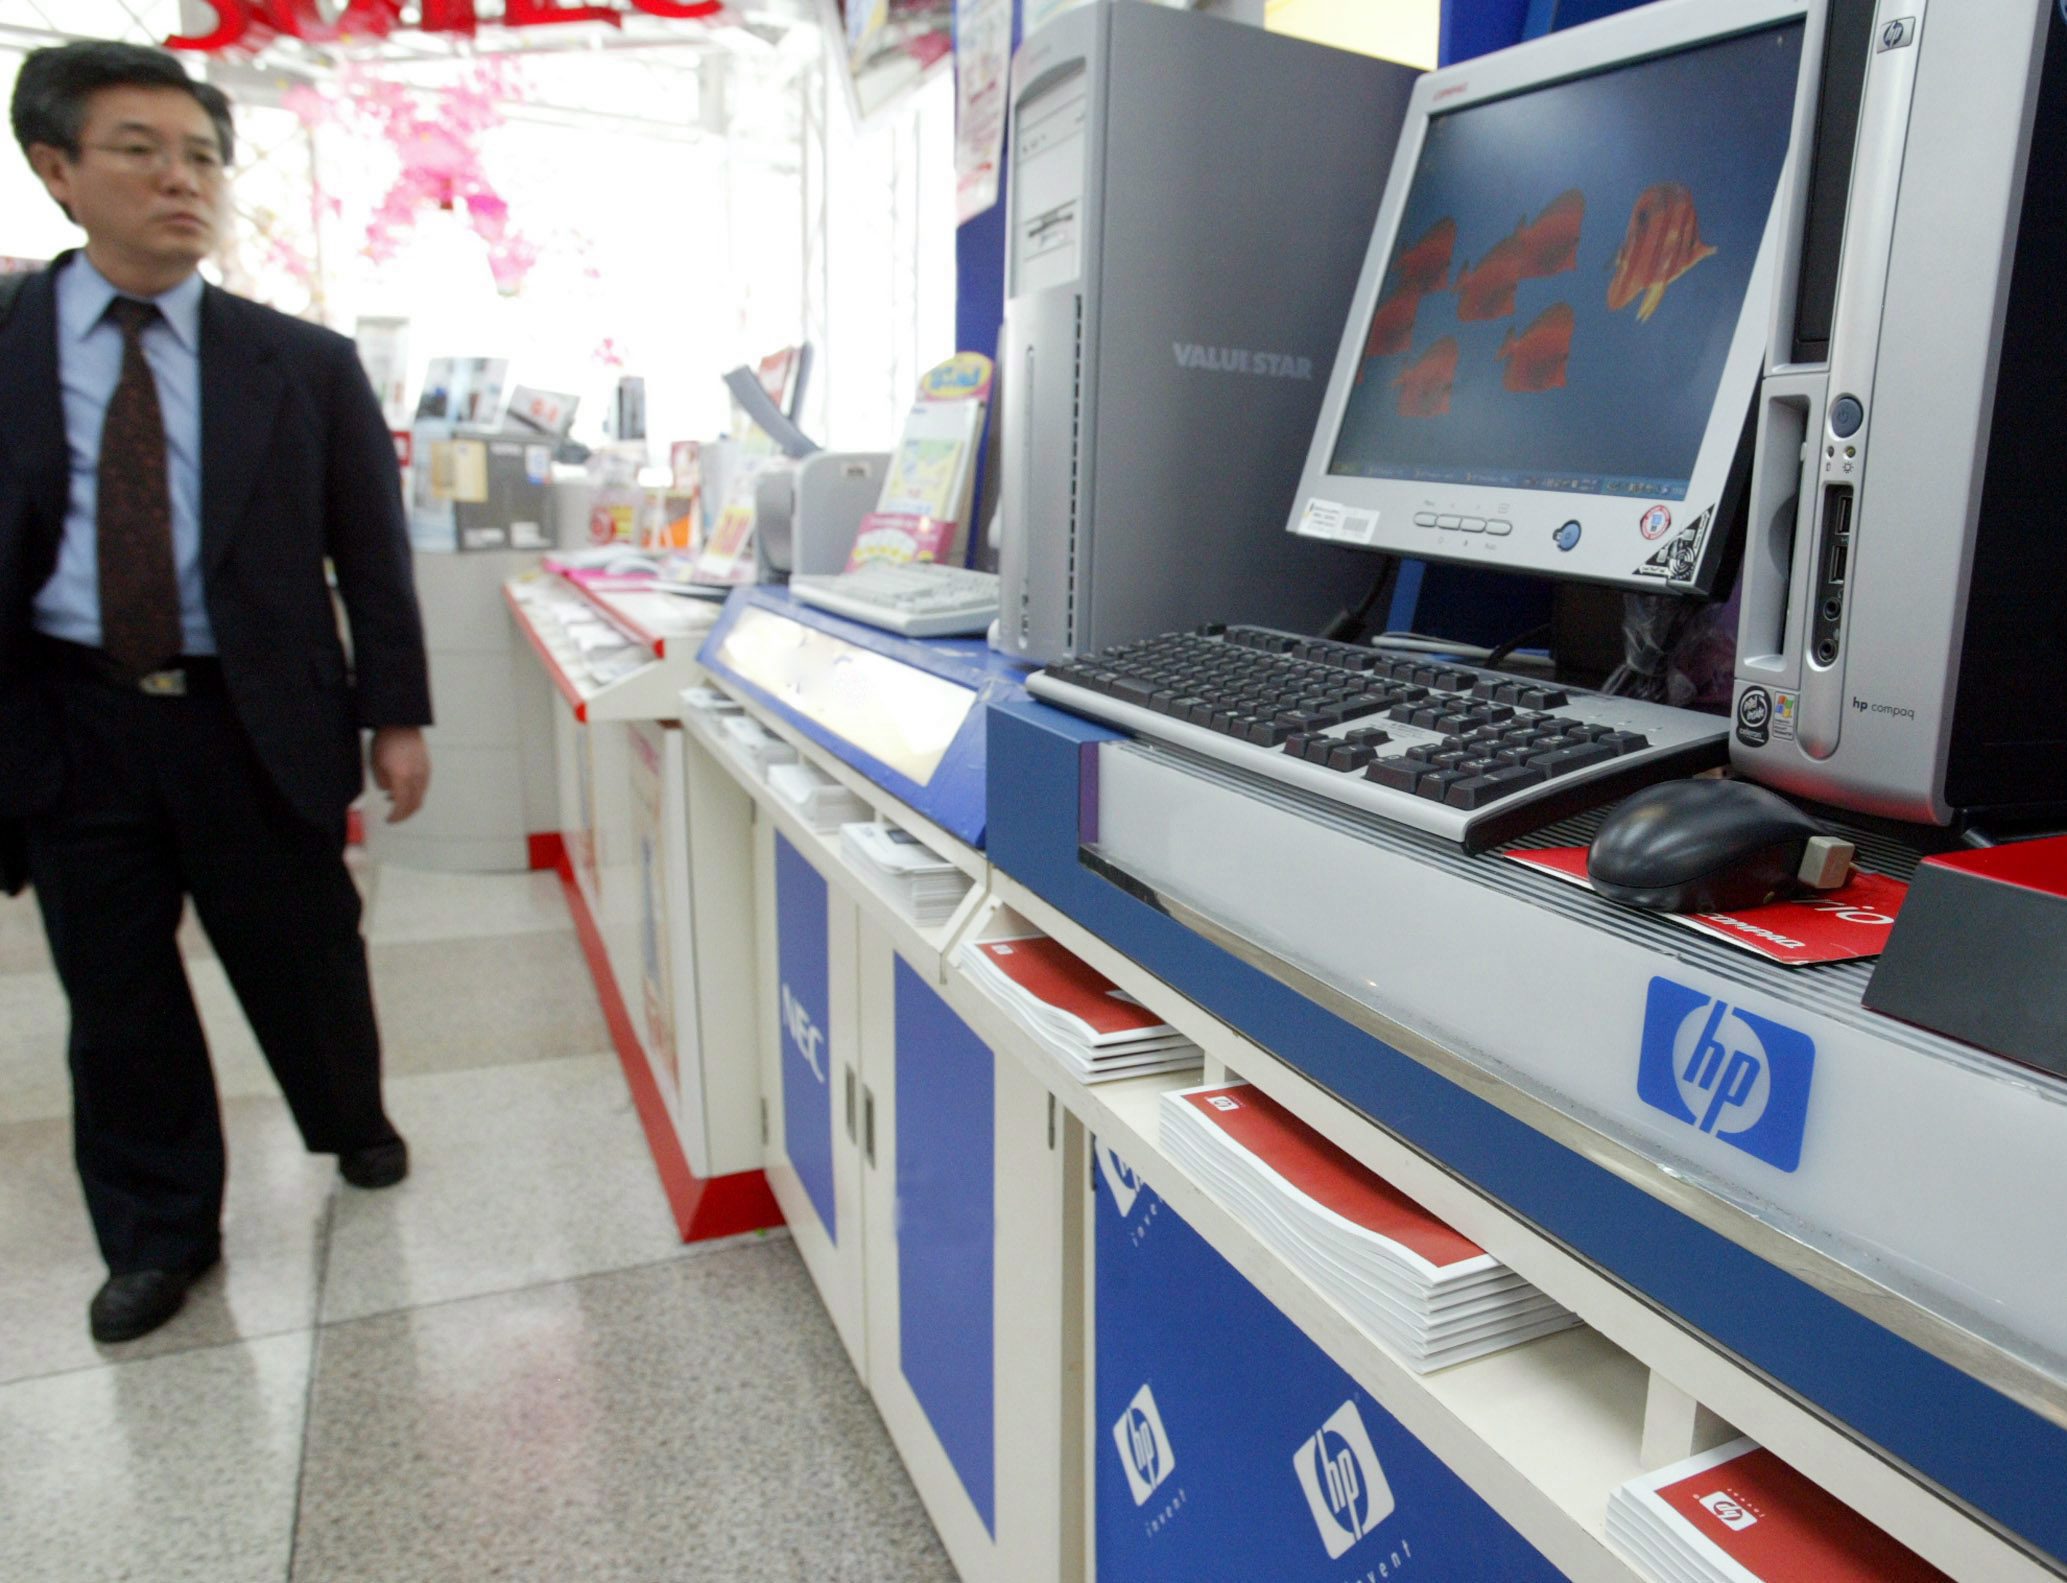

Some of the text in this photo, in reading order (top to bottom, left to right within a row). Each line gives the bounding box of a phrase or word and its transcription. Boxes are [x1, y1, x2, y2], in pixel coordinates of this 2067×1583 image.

[1852, 696, 1916, 721] hp compaq
[782, 983, 825, 1083] NEC
[1682, 1000, 1761, 1134] hp
